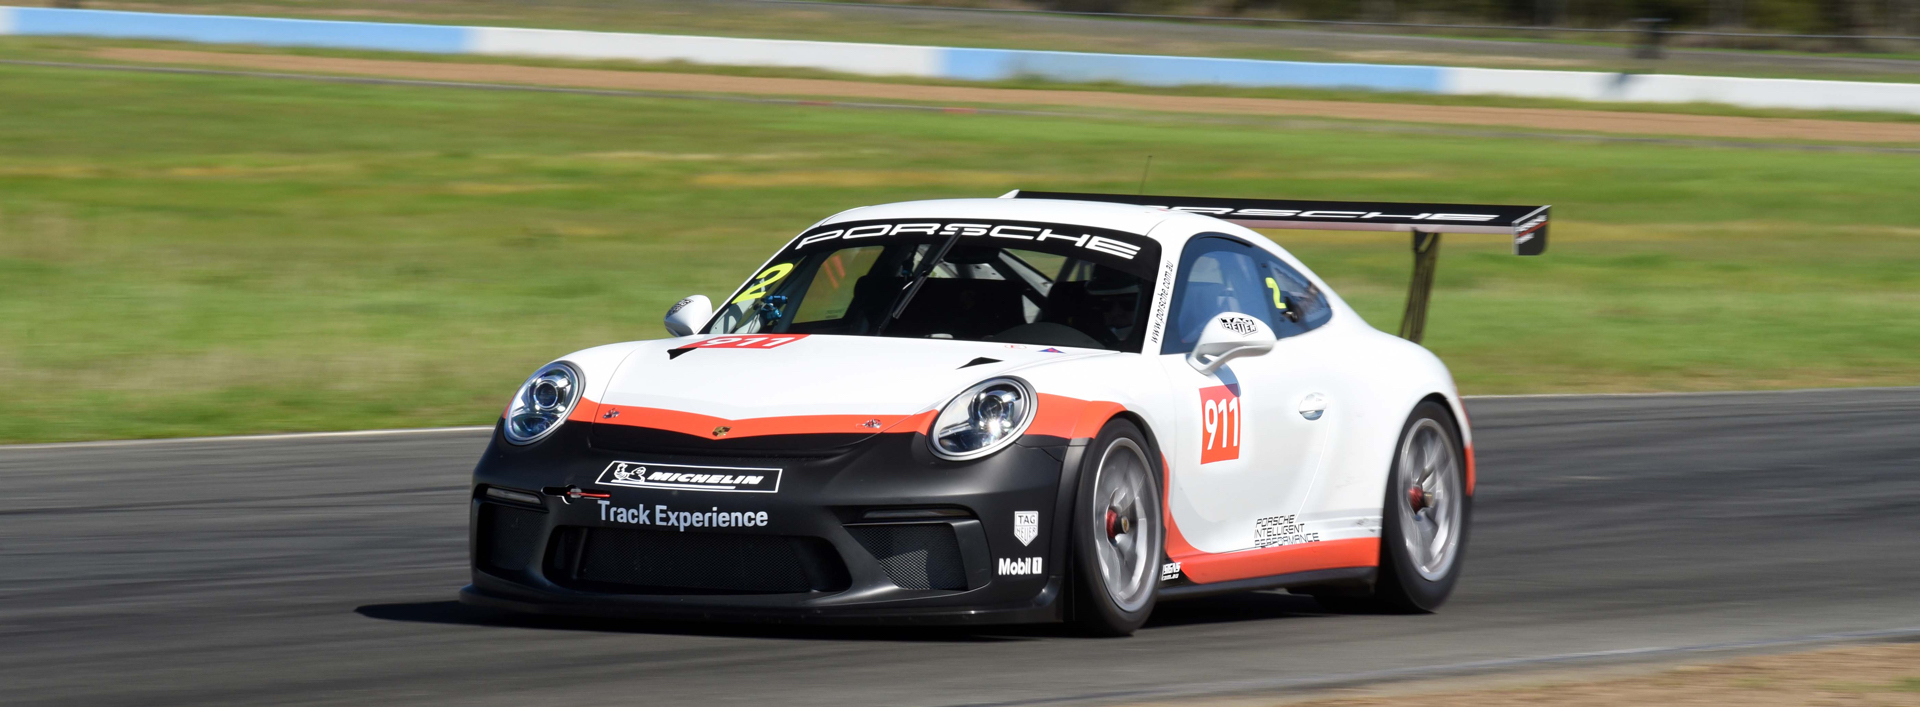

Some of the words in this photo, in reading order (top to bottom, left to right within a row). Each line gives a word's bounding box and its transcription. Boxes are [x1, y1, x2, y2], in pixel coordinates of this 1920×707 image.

[795, 222, 1141, 260] PORSCHE
[731, 263, 794, 304] 2
[1265, 277, 1287, 309] 2
[1151, 260, 1174, 344] www.porsche.com.au
[700, 337, 796, 347] 911
[1205, 397, 1238, 450] 911
[647, 471, 765, 485] MICHELIN
[597, 500, 651, 525] Track
[655, 505, 768, 532] Experience
[1018, 515, 1036, 524] TAG
[1256, 514, 1295, 529] PORSCHE
[1254, 523, 1305, 538] INTELLIGENT
[1254, 532, 1320, 549] PERFORMANCE
[998, 557, 1031, 576] Mobil
